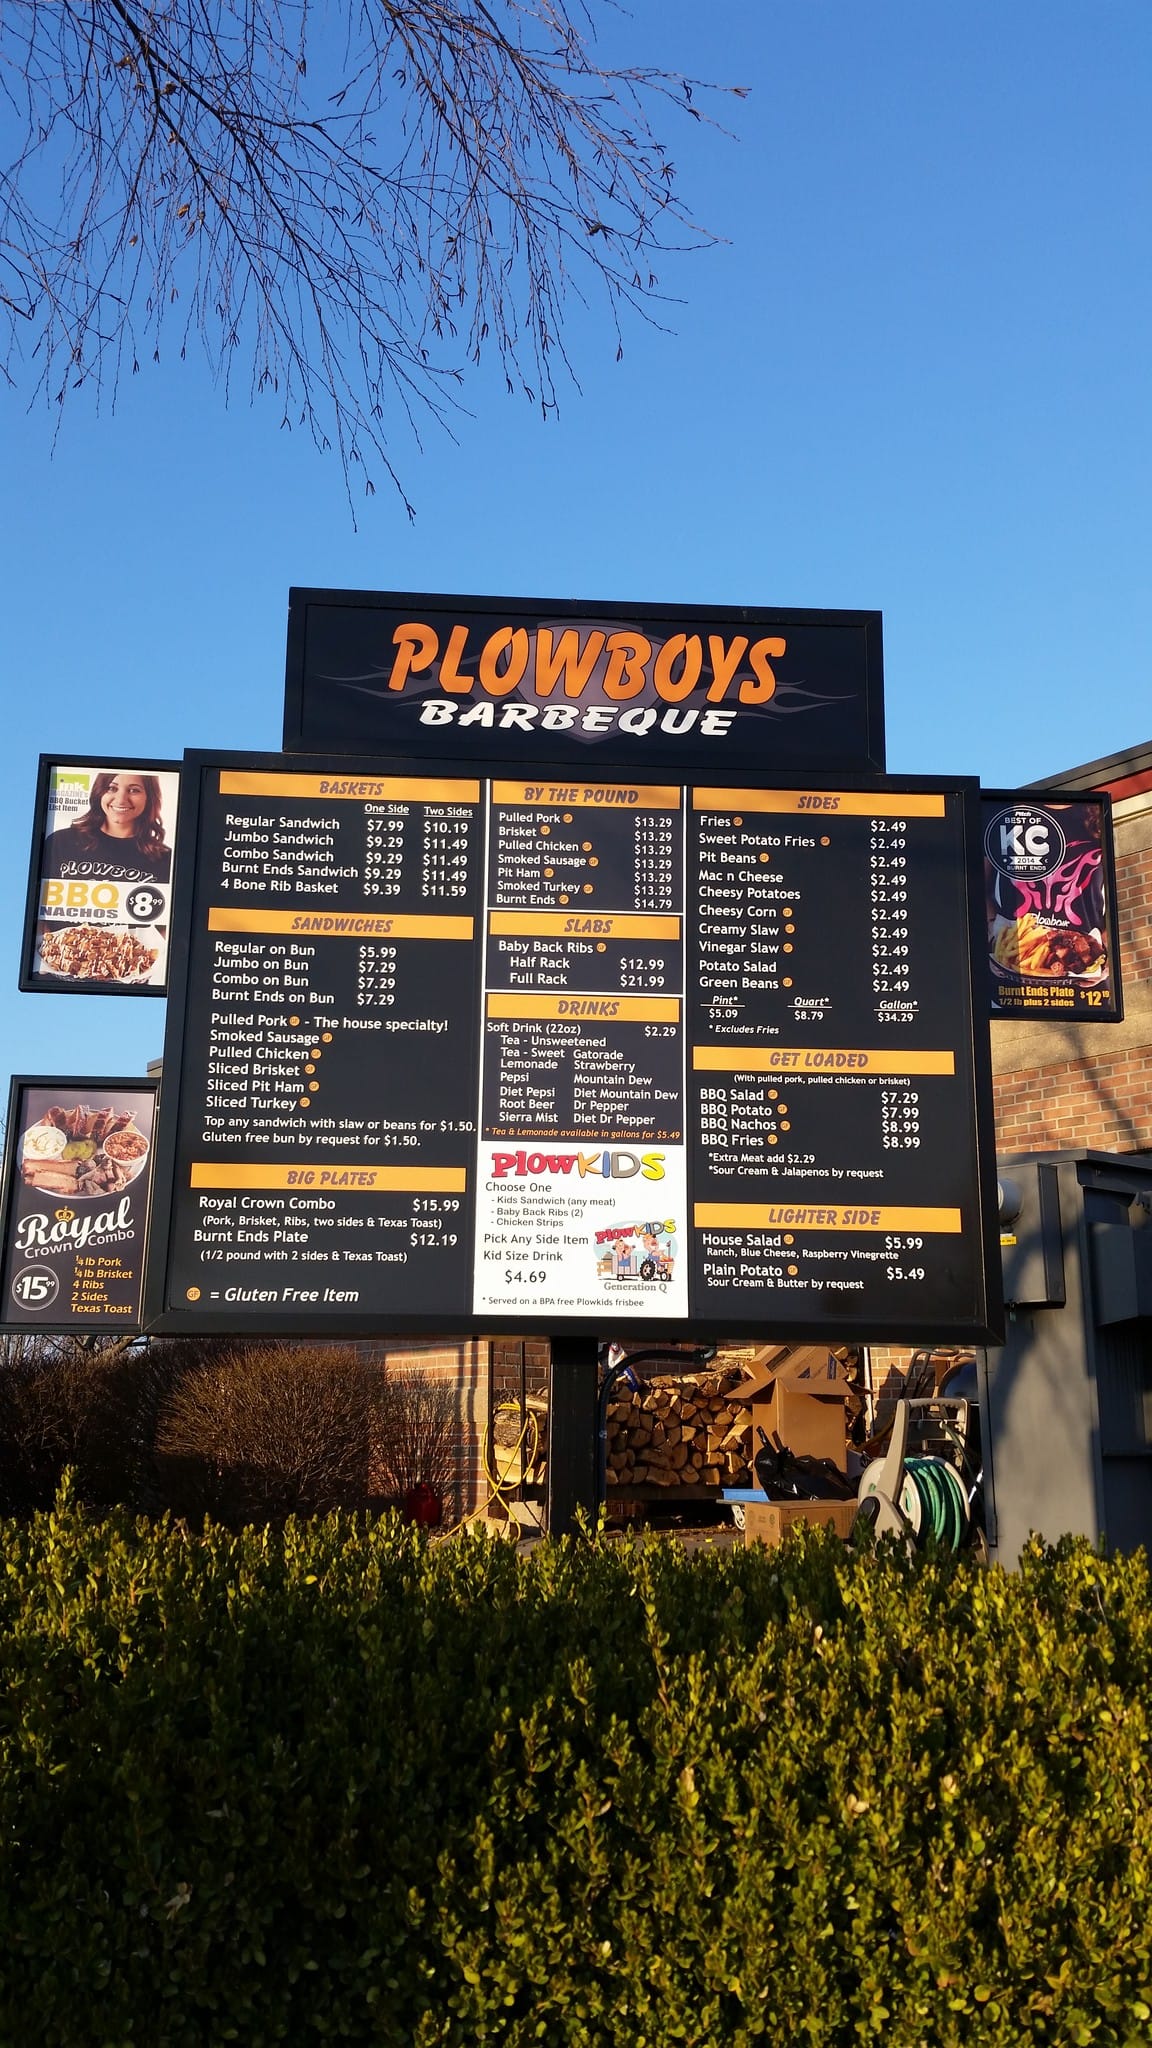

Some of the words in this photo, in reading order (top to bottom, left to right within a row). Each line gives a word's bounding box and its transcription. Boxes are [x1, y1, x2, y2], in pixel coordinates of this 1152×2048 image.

[388, 622, 787, 706] PLOWBOYS
[419, 700, 738, 736] BARBEQUE
[319, 781, 384, 796] BASKETS
[524, 787, 545, 801] BY
[549, 788, 579, 802] THE
[583, 789, 639, 804] POUND
[365, 804, 385, 814] One
[388, 804, 410, 815] Side
[424, 806, 445, 816] Two
[447, 807, 473, 817] Sides
[797, 796, 841, 810] SIDES
[225, 814, 275, 828] Regular
[279, 817, 340, 830] Sandwich
[367, 820, 404, 832] $7.99
[424, 822, 469, 835] $10.19
[700, 816, 731, 828] Fries
[870, 820, 907, 833] $2.49
[699, 833, 737, 845] Sweet
[741, 834, 781, 846] Potato
[785, 835, 816, 848] Fries
[870, 837, 906, 850] $2.49
[1000, 825, 1050, 856] KC
[42, 881, 119, 909] BBQ
[220, 878, 230, 889] 4
[233, 879, 267, 891] Bone
[271, 880, 292, 892] Rib
[296, 881, 339, 894] Basket
[363, 883, 401, 896] $9.39
[422, 884, 467, 897] $11.59
[496, 894, 527, 904] Burnt
[530, 895, 556, 905] Ends
[634, 898, 673, 909] $14.79
[40, 906, 118, 919] NACHOS
[291, 916, 394, 933] SANDWICHES
[564, 919, 614, 934] SLABS
[215, 941, 266, 955] Regular
[269, 946, 287, 955] on
[290, 944, 315, 957] Bun
[359, 946, 397, 959] $5.99
[499, 941, 530, 953] Baby
[534, 942, 563, 953] Back
[567, 943, 594, 954] Ribs
[510, 957, 537, 968] Half
[540, 957, 570, 969] Rack
[620, 958, 665, 971] $12.99
[999, 986, 1025, 996] Burnt
[1026, 987, 1049, 996] Ends
[1050, 987, 1075, 997] Plate
[558, 1000, 620, 1016] DRINKS
[1024, 999, 1042, 1007] plus
[1051, 999, 1075, 1007] sides
[709, 1008, 738, 1019] $5.09
[794, 1010, 824, 1021] $8.79
[878, 1012, 914, 1023] $34.29
[211, 1013, 254, 1026] Pulled
[258, 1014, 288, 1027] Pork
[314, 1016, 340, 1028] The
[343, 1017, 382, 1030] house
[385, 1018, 449, 1033] specialty!
[487, 1022, 510, 1033] Soft
[513, 1023, 543, 1033] Drink
[546, 1023, 581, 1035] (22oz)
[645, 1026, 677, 1037] $2.29
[501, 1035, 520, 1046] Tea
[531, 1036, 607, 1047] Unsweetened
[573, 1050, 624, 1060] Gatorade
[770, 1052, 801, 1068] GET
[804, 1052, 868, 1068] LOADED
[500, 1059, 559, 1070] Lemonade
[574, 1060, 635, 1073] Strawberry
[204, 1116, 226, 1128] Top
[228, 1118, 249, 1129] any
[253, 1116, 306, 1129] sandwich
[310, 1117, 336, 1129] with
[339, 1118, 364, 1130] slaw
[367, 1121, 380, 1130] or
[383, 1120, 417, 1132] beans
[419, 1120, 437, 1131] for
[440, 1120, 476, 1133] $1.50.
[701, 1118, 729, 1131] BBQ
[731, 1118, 777, 1131] Nachos
[882, 1120, 920, 1133] $8.99
[741, 1153, 765, 1163] Meat
[767, 1154, 785, 1164] add
[787, 1154, 816, 1165] $2.29
[287, 1170, 316, 1186] BIG
[319, 1171, 378, 1187] PLATES
[485, 1182, 526, 1193] Choose
[530, 1182, 552, 1193] One
[199, 1196, 237, 1212] Royal
[241, 1197, 285, 1211] Crown
[288, 1197, 336, 1211] Combo
[412, 1199, 460, 1213] $15.99
[15, 1196, 134, 1249] Royal
[202, 1215, 235, 1228] (Pork,
[238, 1215, 281, 1229] Brisket,
[284, 1216, 311, 1229] Ribs,
[314, 1217, 335, 1228] two
[337, 1216, 365, 1229] sides
[367, 1217, 376, 1228] &
[378, 1217, 408, 1229] Texas
[411, 1217, 442, 1230] Toast)
[769, 1208, 837, 1226] LIGHTER
[842, 1210, 881, 1226] SIDE
[24, 1243, 73, 1259] Crown
[88, 1230, 135, 1246] Combo
[702, 1233, 743, 1246] House
[747, 1234, 782, 1247] Salad
[885, 1237, 923, 1250] $5.99
[98, 1258, 122, 1266] Pork
[484, 1251, 502, 1261] Kid
[505, 1251, 530, 1262] Size
[533, 1251, 563, 1262] Drink
[96, 1270, 133, 1279] Brisket
[505, 1270, 547, 1284] $4.69
[73, 1281, 80, 1289] 4
[82, 1281, 104, 1289] Ribs
[604, 1282, 657, 1293] Generation
[659, 1283, 668, 1294] Q
[72, 1293, 79, 1301] 2
[81, 1293, 108, 1301] Sides
[225, 1287, 278, 1303] Gluten
[282, 1288, 319, 1303] Free
[323, 1288, 360, 1303] Item
[489, 1297, 517, 1305] Served
[520, 1298, 530, 1306] on
[540, 1297, 555, 1306] BPA
[557, 1297, 574, 1306] free
[577, 1298, 613, 1307] Plowkids
[615, 1298, 644, 1307] frisbee
[71, 1304, 101, 1313] Texas
[104, 1304, 133, 1313] Toast
